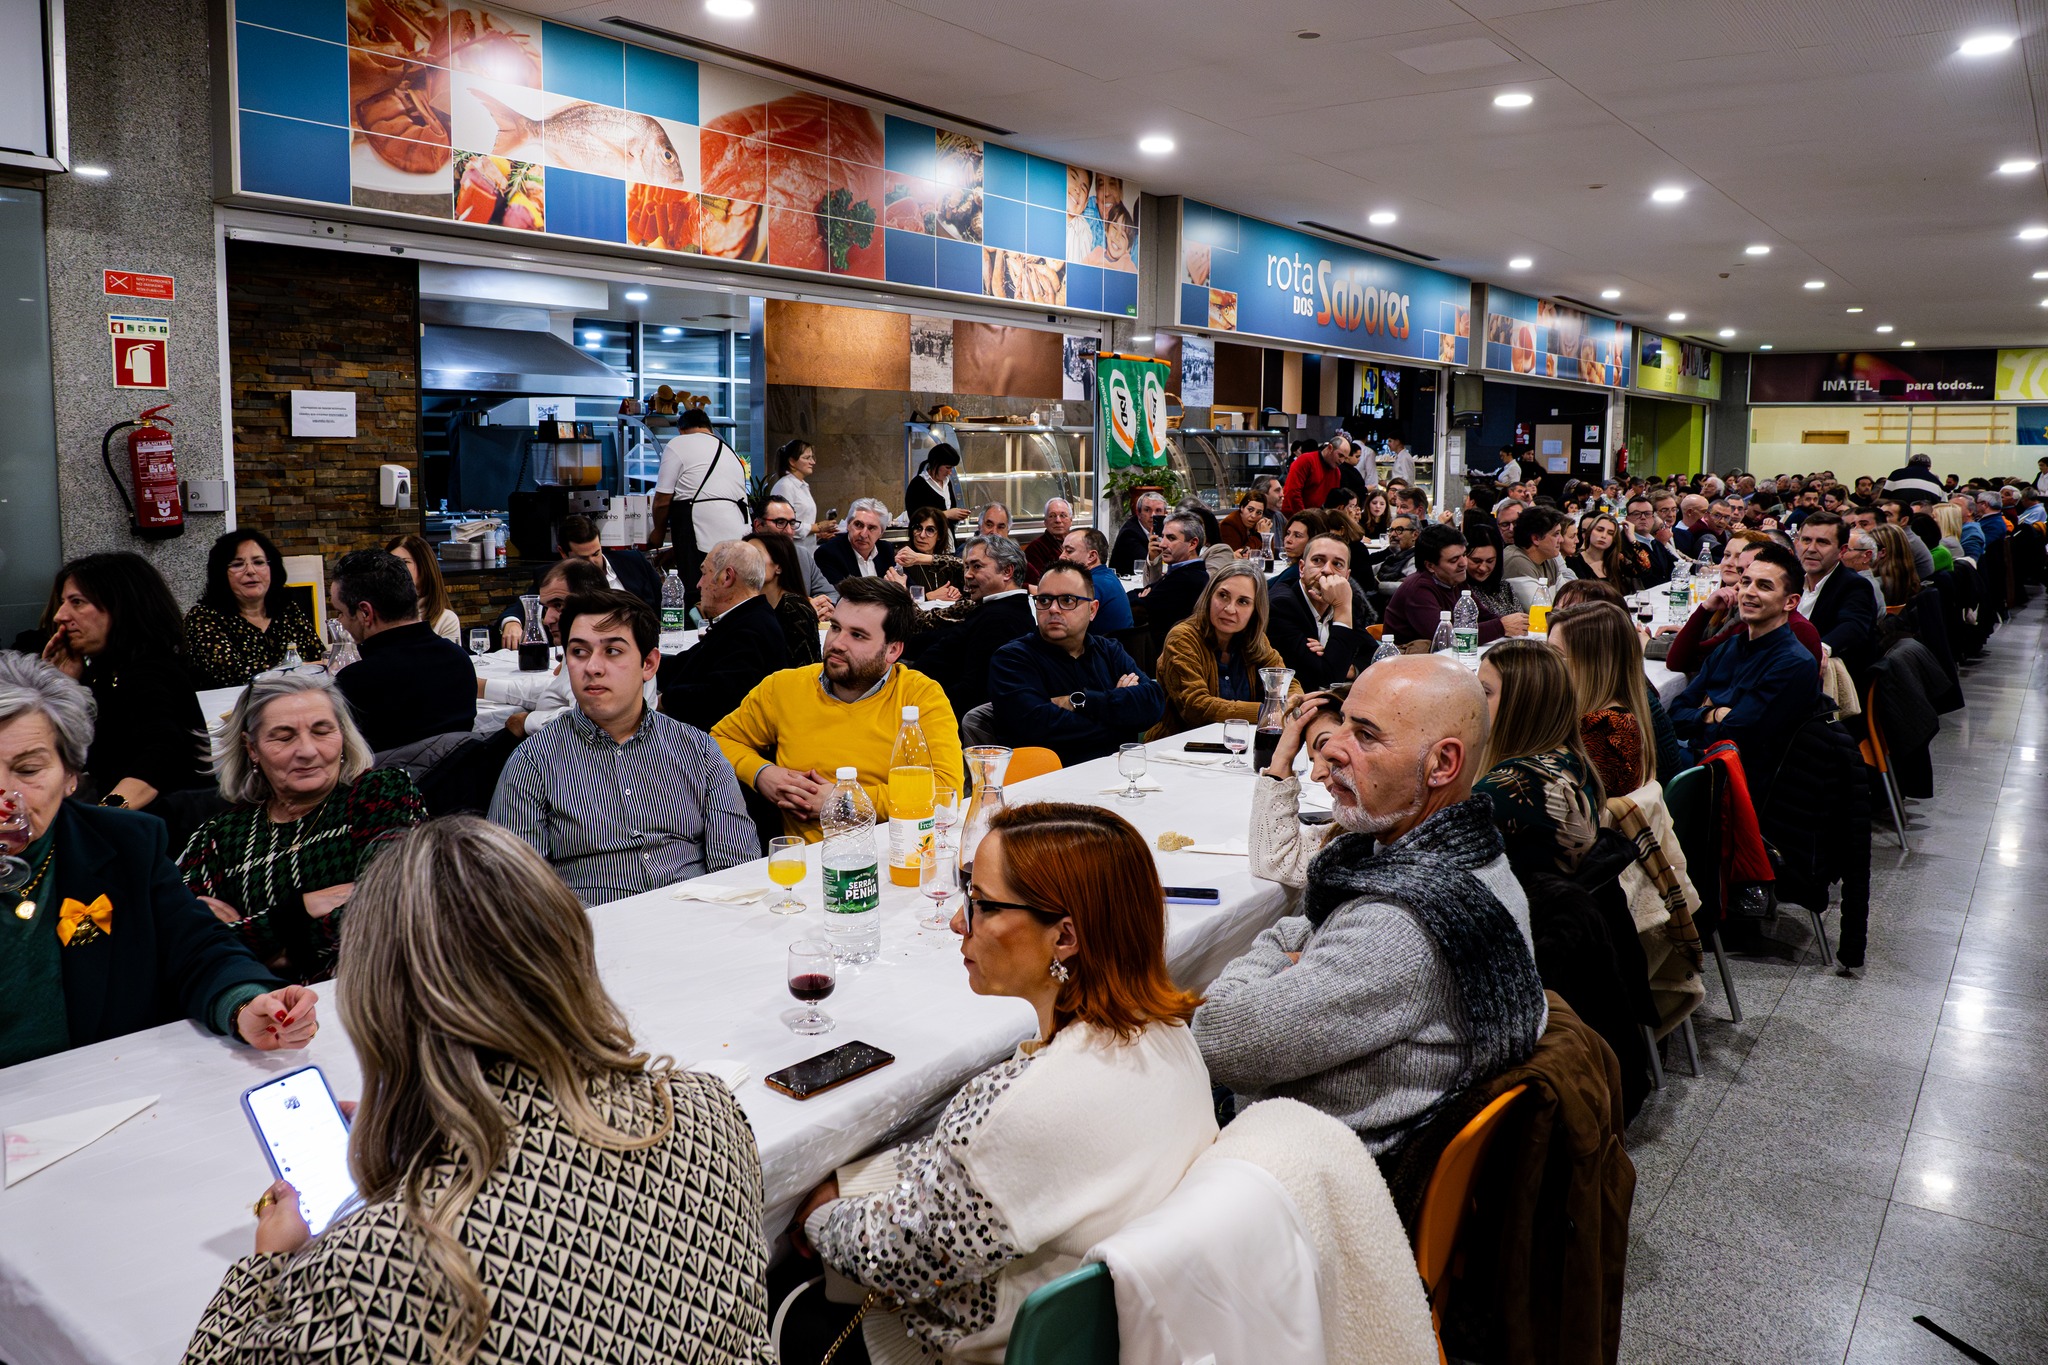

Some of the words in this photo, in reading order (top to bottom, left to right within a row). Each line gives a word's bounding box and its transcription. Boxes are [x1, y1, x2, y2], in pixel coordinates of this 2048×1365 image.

[1267, 252, 1313, 295] rota
[1293, 295, 1313, 317] DOS
[1317, 259, 1410, 339] Sabores
[1906, 382, 1934, 392] para
[1937, 380, 1985, 390] todos...
[1117, 390, 1128, 427] JSD
[845, 883, 878, 900] PENHA
[848, 878, 872, 890] SERRA
